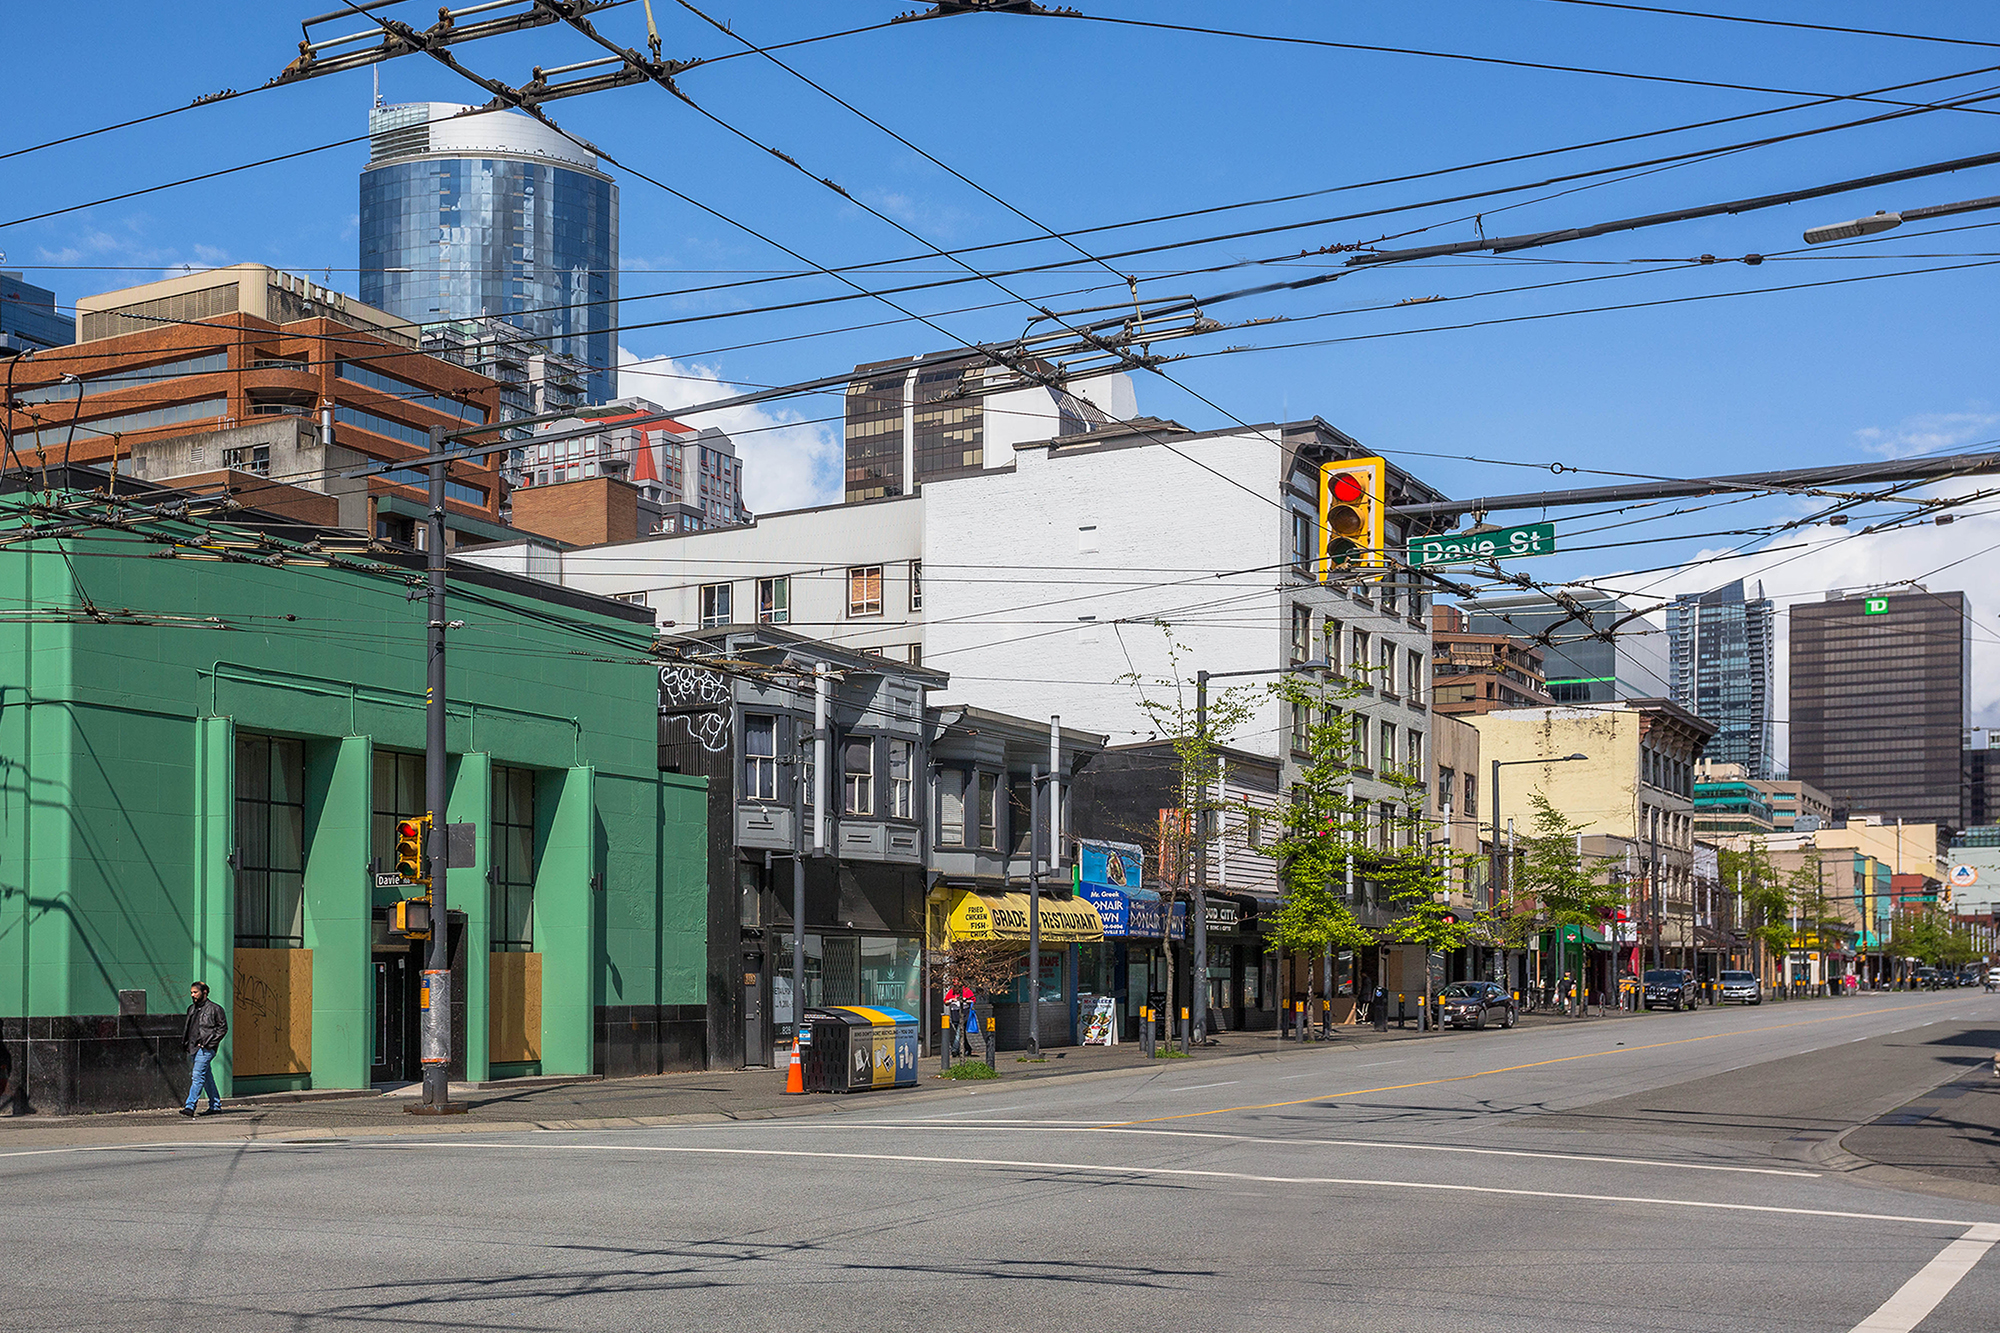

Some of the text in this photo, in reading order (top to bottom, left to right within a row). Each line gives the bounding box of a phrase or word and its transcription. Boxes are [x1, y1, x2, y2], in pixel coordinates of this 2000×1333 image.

[1423, 530, 1541, 563] Davie St
[1867, 600, 1886, 611] TD
[379, 875, 400, 885] Davie
[967, 906, 984, 914] FRIED
[992, 909, 1098, 930] GRADE RESTAURANT
[970, 922, 986, 930] FISH
